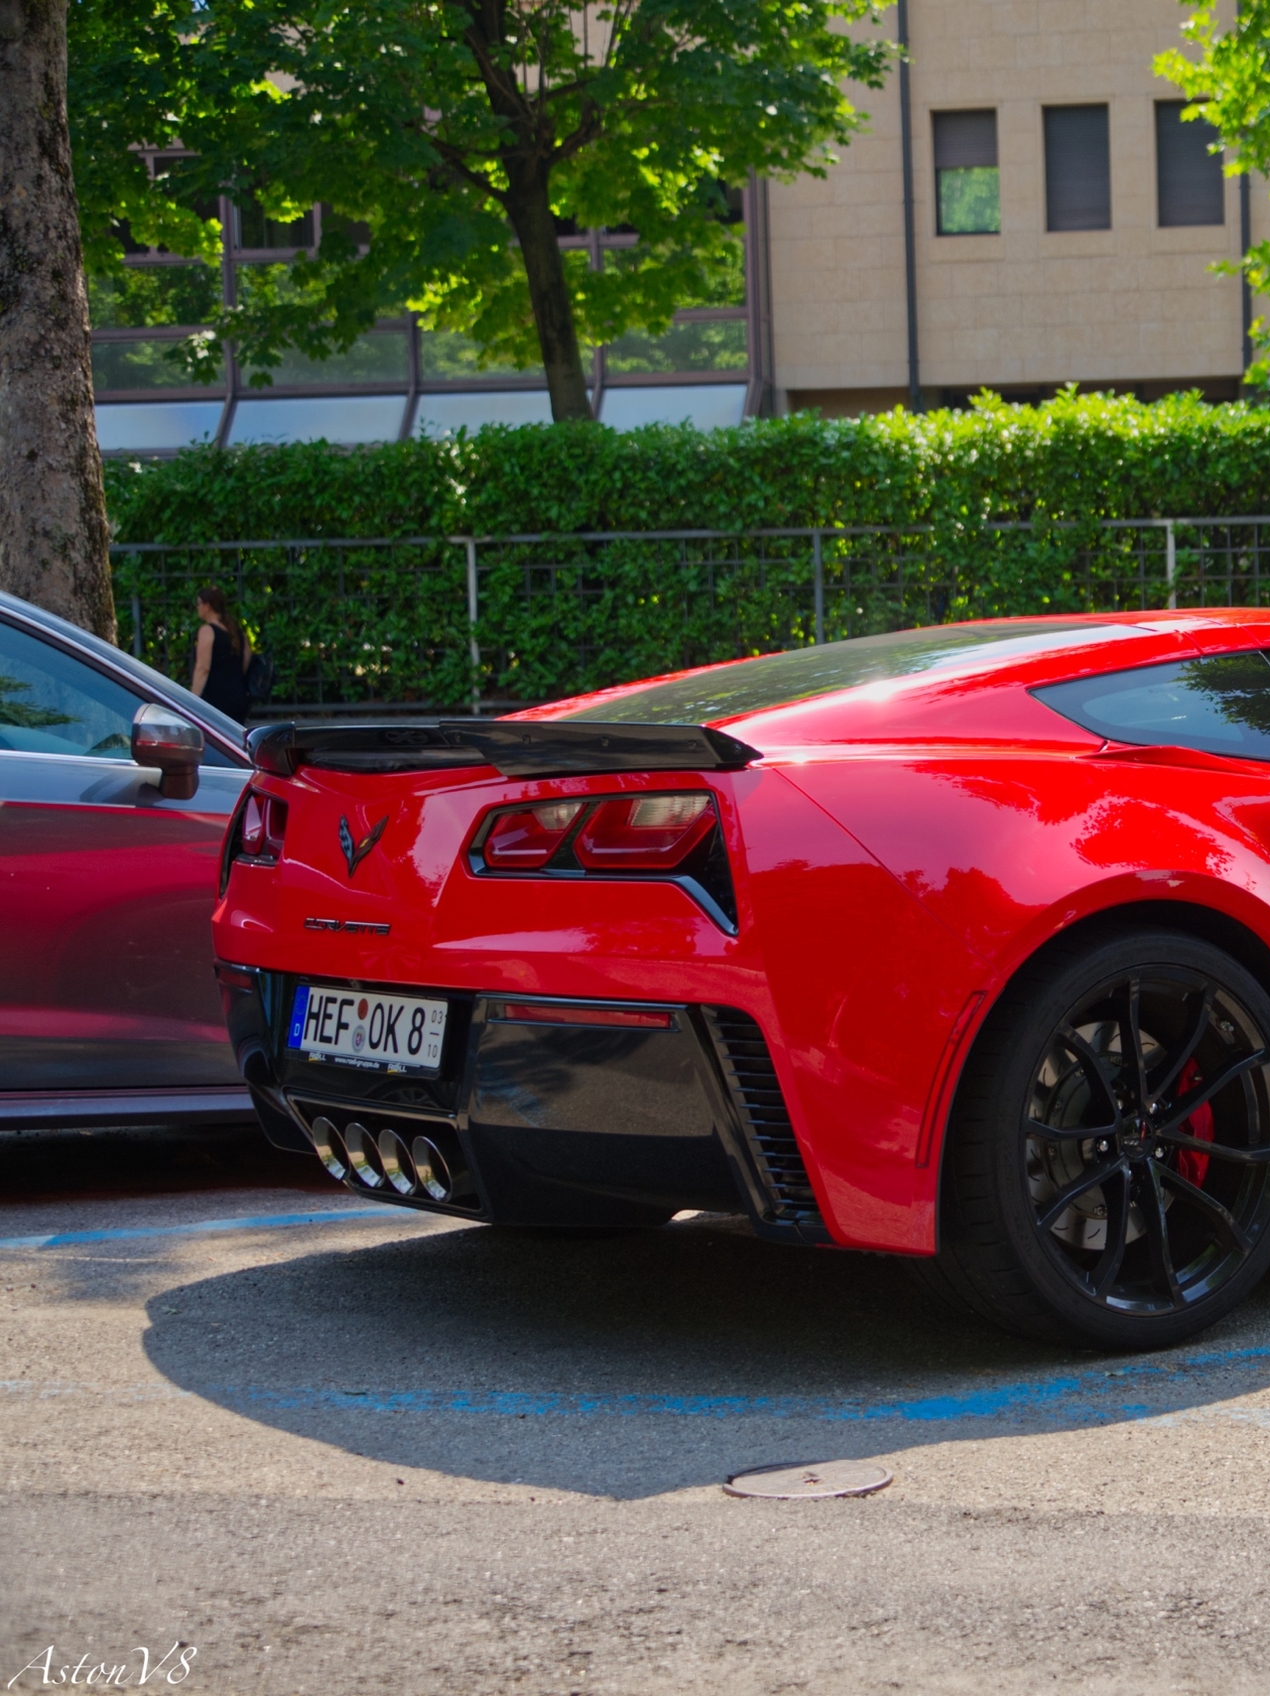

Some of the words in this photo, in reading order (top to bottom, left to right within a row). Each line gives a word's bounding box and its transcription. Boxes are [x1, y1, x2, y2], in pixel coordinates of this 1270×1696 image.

[304, 917, 391, 936] CORVETTE
[304, 994, 355, 1046] HEF
[368, 1002, 405, 1054] OK
[407, 1007, 426, 1056] 8
[431, 1009, 444, 1025] 03
[293, 1023, 301, 1037] D
[426, 1043, 439, 1059] 10
